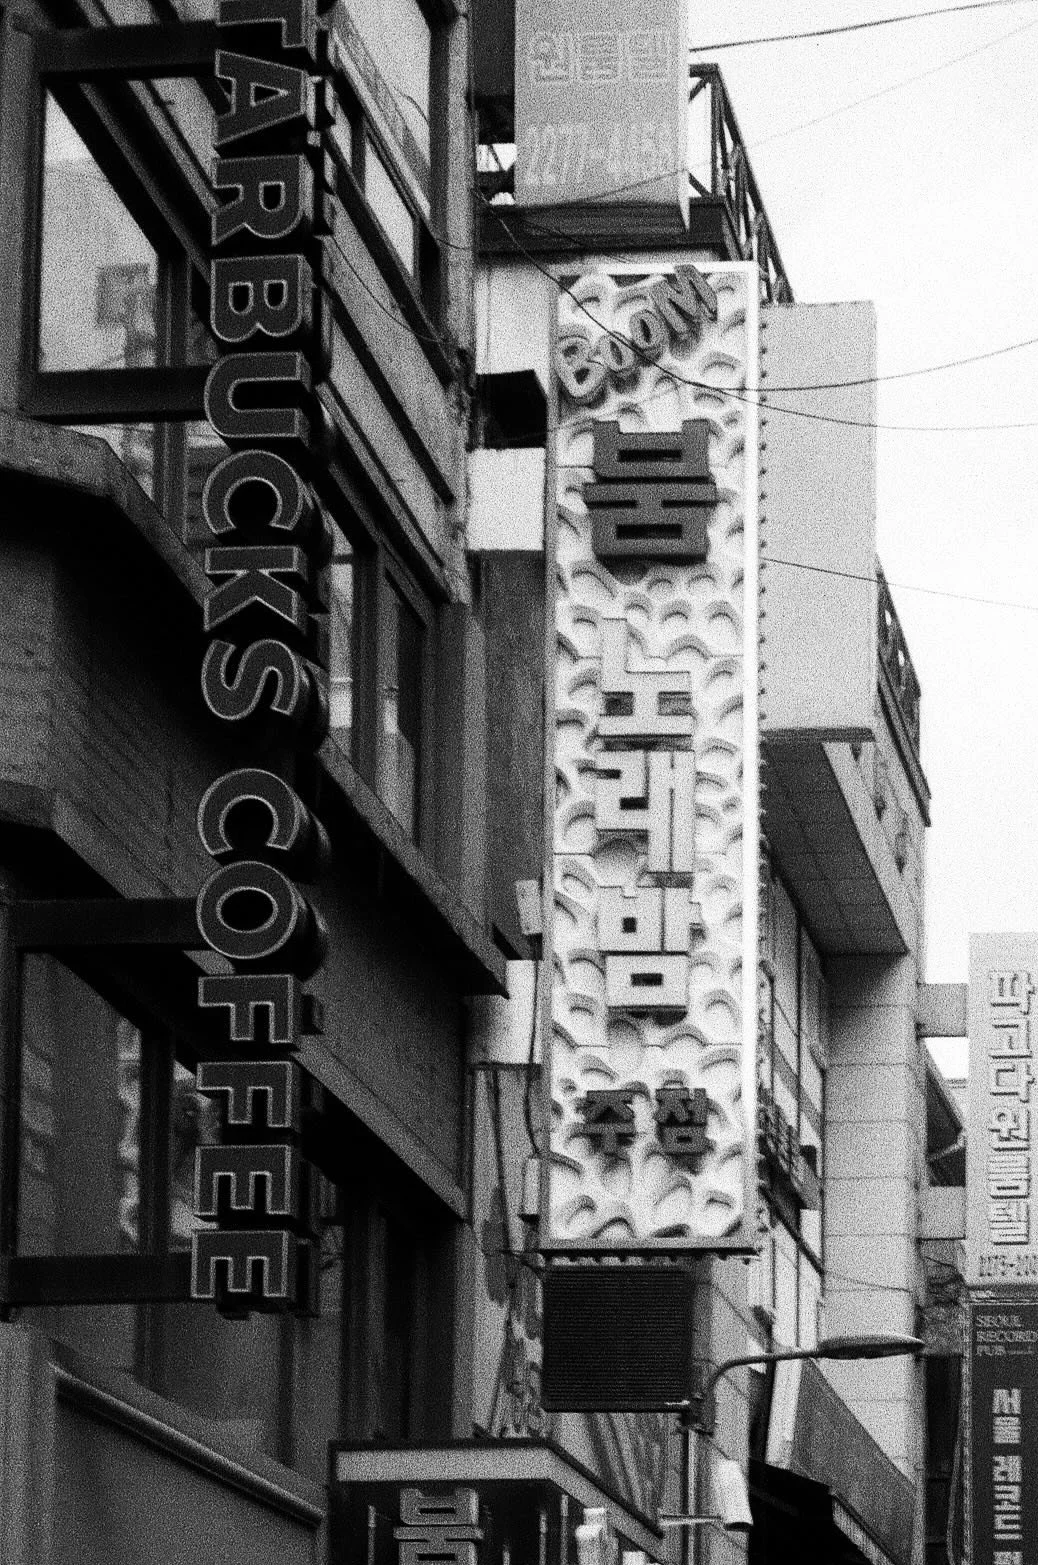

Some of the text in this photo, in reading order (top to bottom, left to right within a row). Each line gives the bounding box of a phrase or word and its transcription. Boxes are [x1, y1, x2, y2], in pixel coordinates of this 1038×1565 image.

[191, 767, 300, 1302] COFFEE
[585, 1087, 709, 1158] 주점
[975, 1313, 1023, 1329] SEOUL
[976, 1344, 1006, 1357] PUB
[991, 1455, 1024, 1541] 레코드
